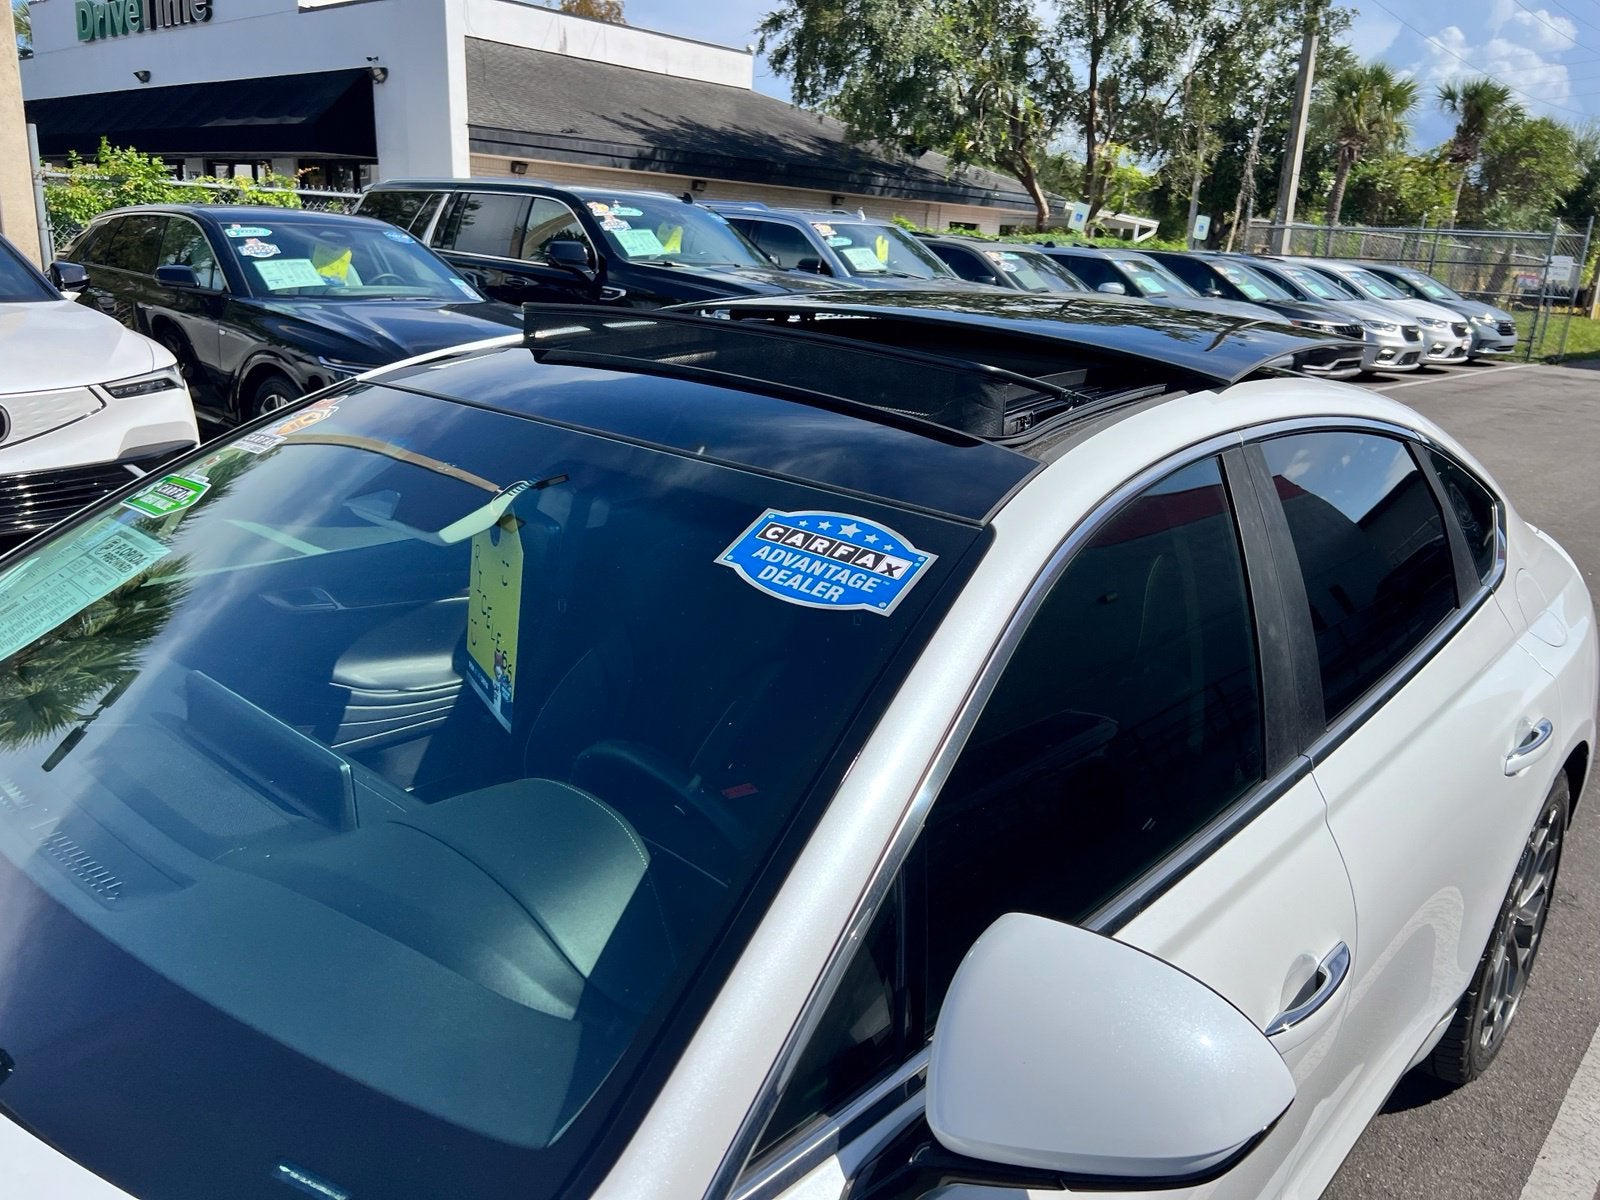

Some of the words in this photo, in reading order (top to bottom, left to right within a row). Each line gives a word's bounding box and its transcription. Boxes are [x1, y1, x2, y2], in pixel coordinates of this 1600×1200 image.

[751, 545, 882, 593] ADVANTAGE
[765, 526, 903, 578] CARFAX
[757, 565, 846, 603] DEALER
